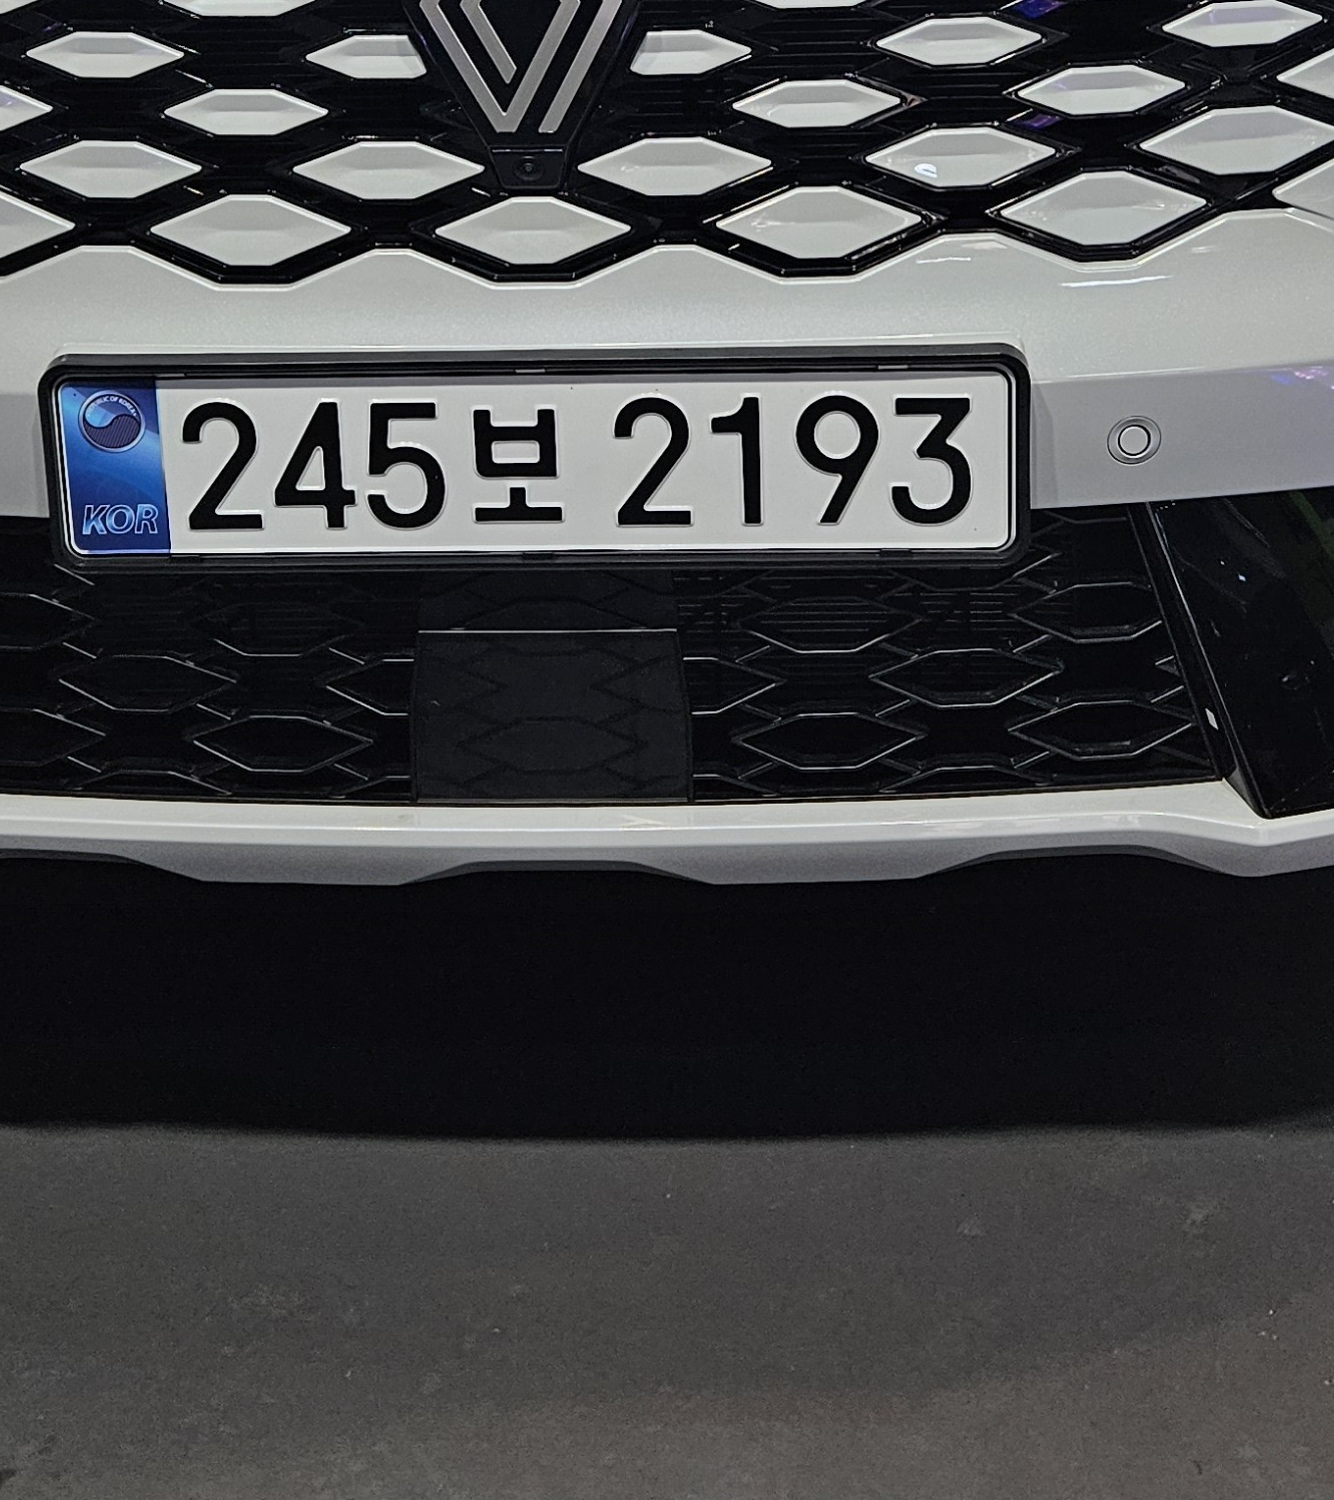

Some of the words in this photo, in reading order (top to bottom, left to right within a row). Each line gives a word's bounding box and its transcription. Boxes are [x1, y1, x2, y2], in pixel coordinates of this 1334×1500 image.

[181, 400, 563, 531] 245보
[613, 394, 972, 526] 2193
[82, 504, 159, 535] KOR
